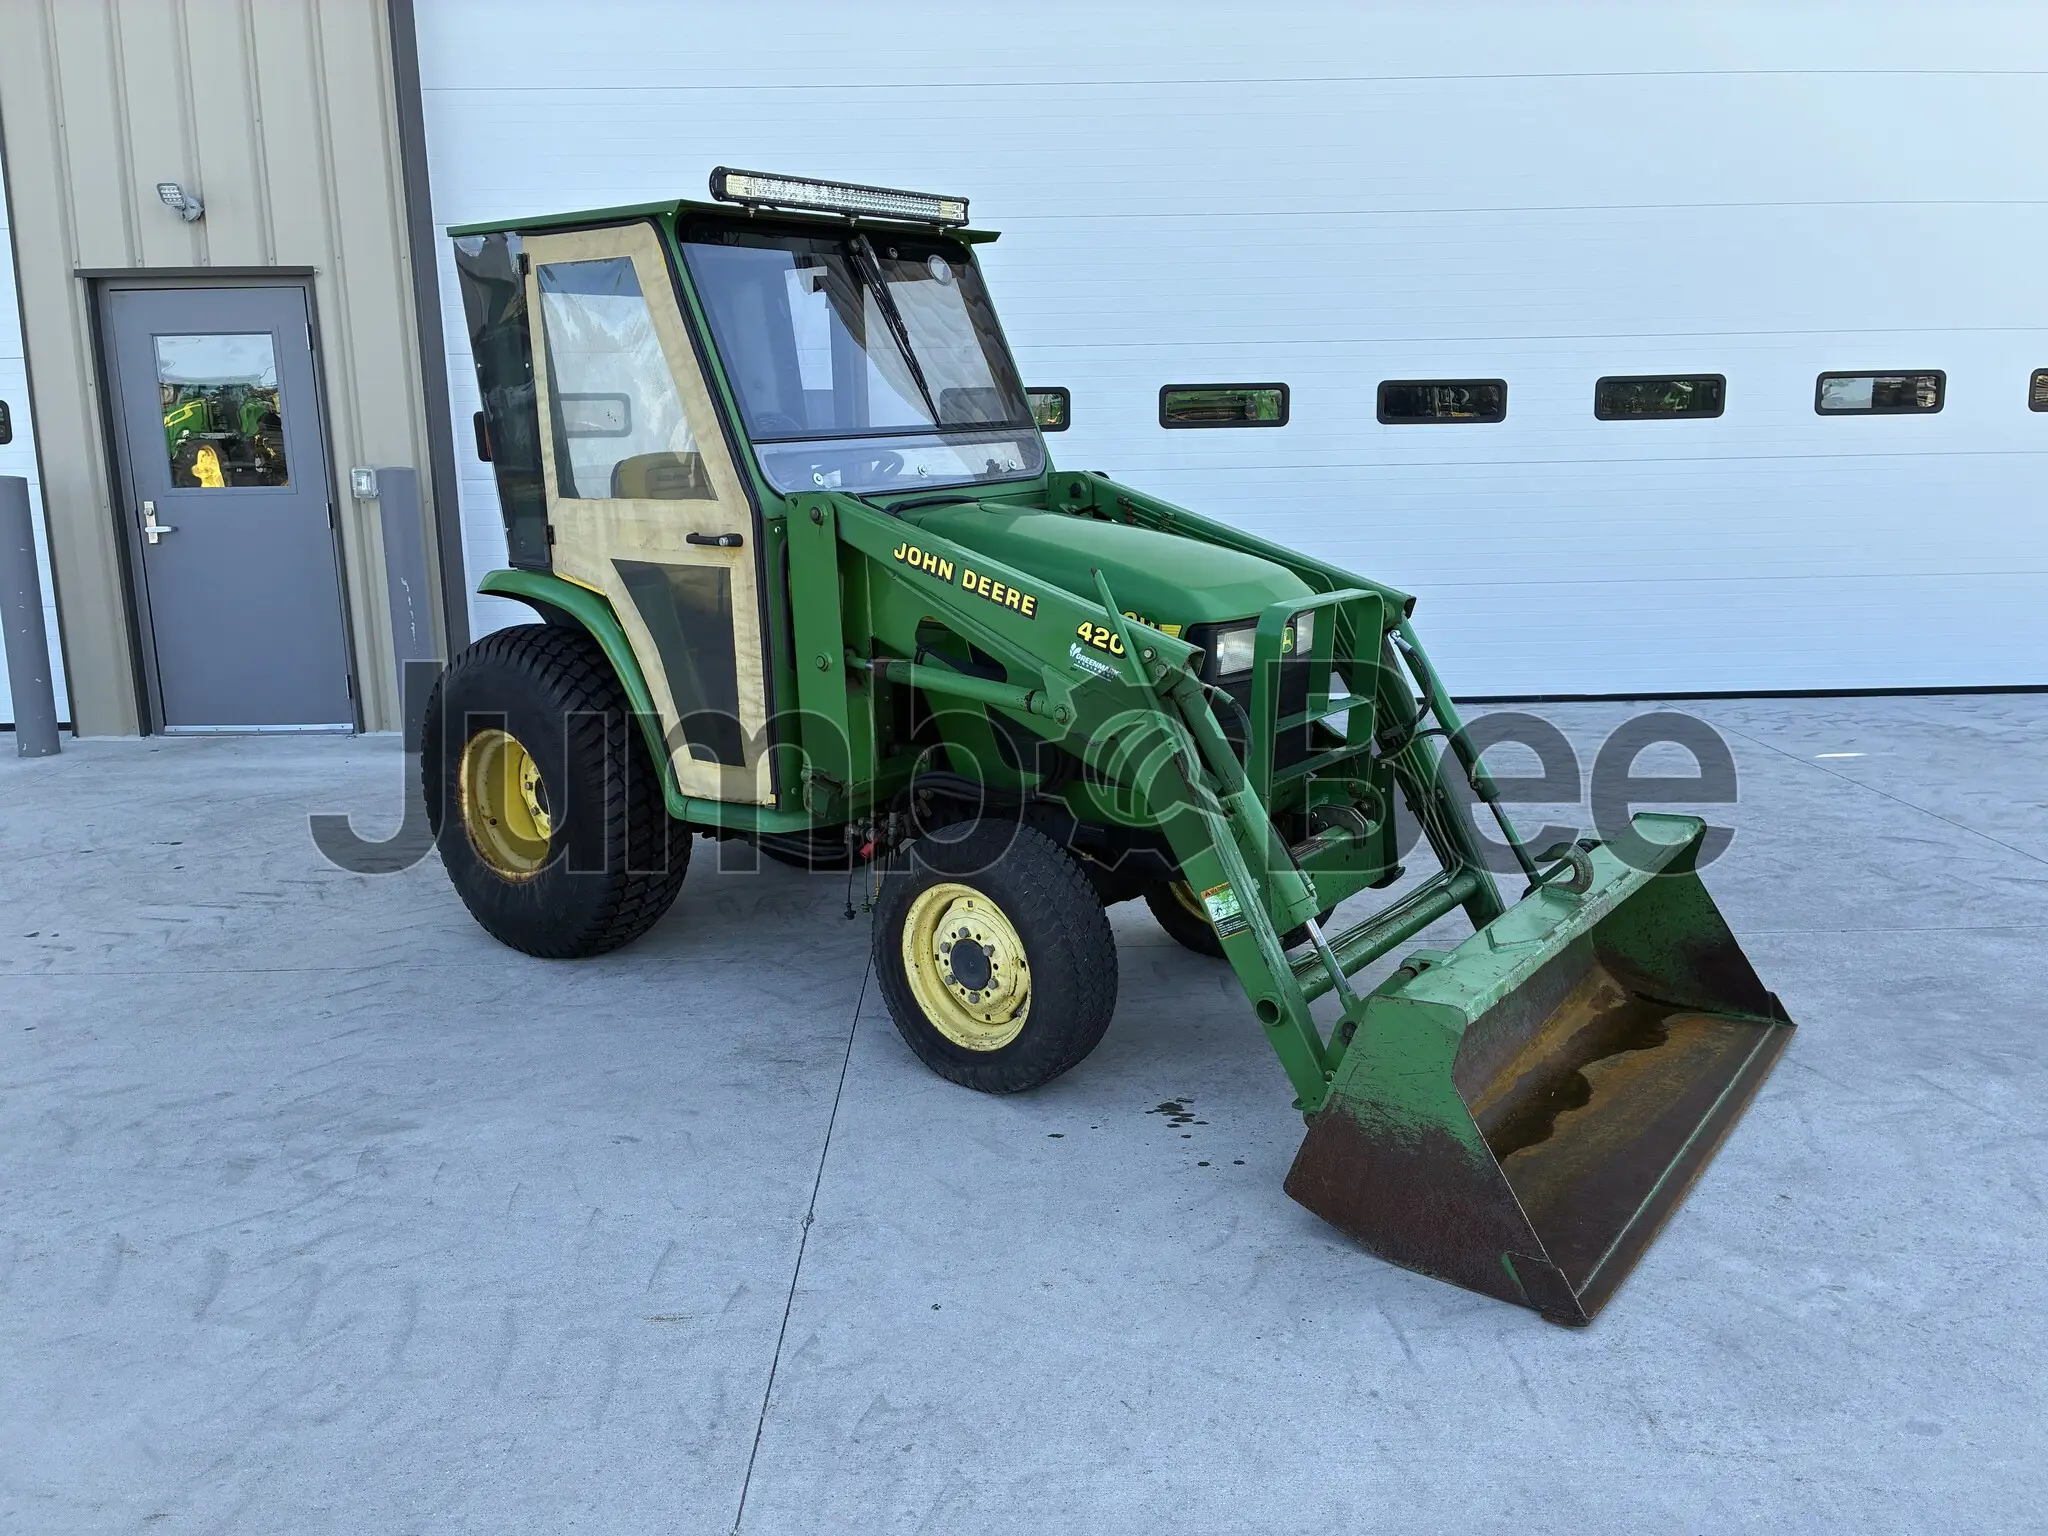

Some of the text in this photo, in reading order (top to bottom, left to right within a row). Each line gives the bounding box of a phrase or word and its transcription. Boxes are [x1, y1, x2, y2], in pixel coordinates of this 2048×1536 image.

[893, 542, 1038, 620] JOHN DEERE
[1077, 621, 1126, 657] 420
[1075, 653, 1120, 677] GREENMARK
